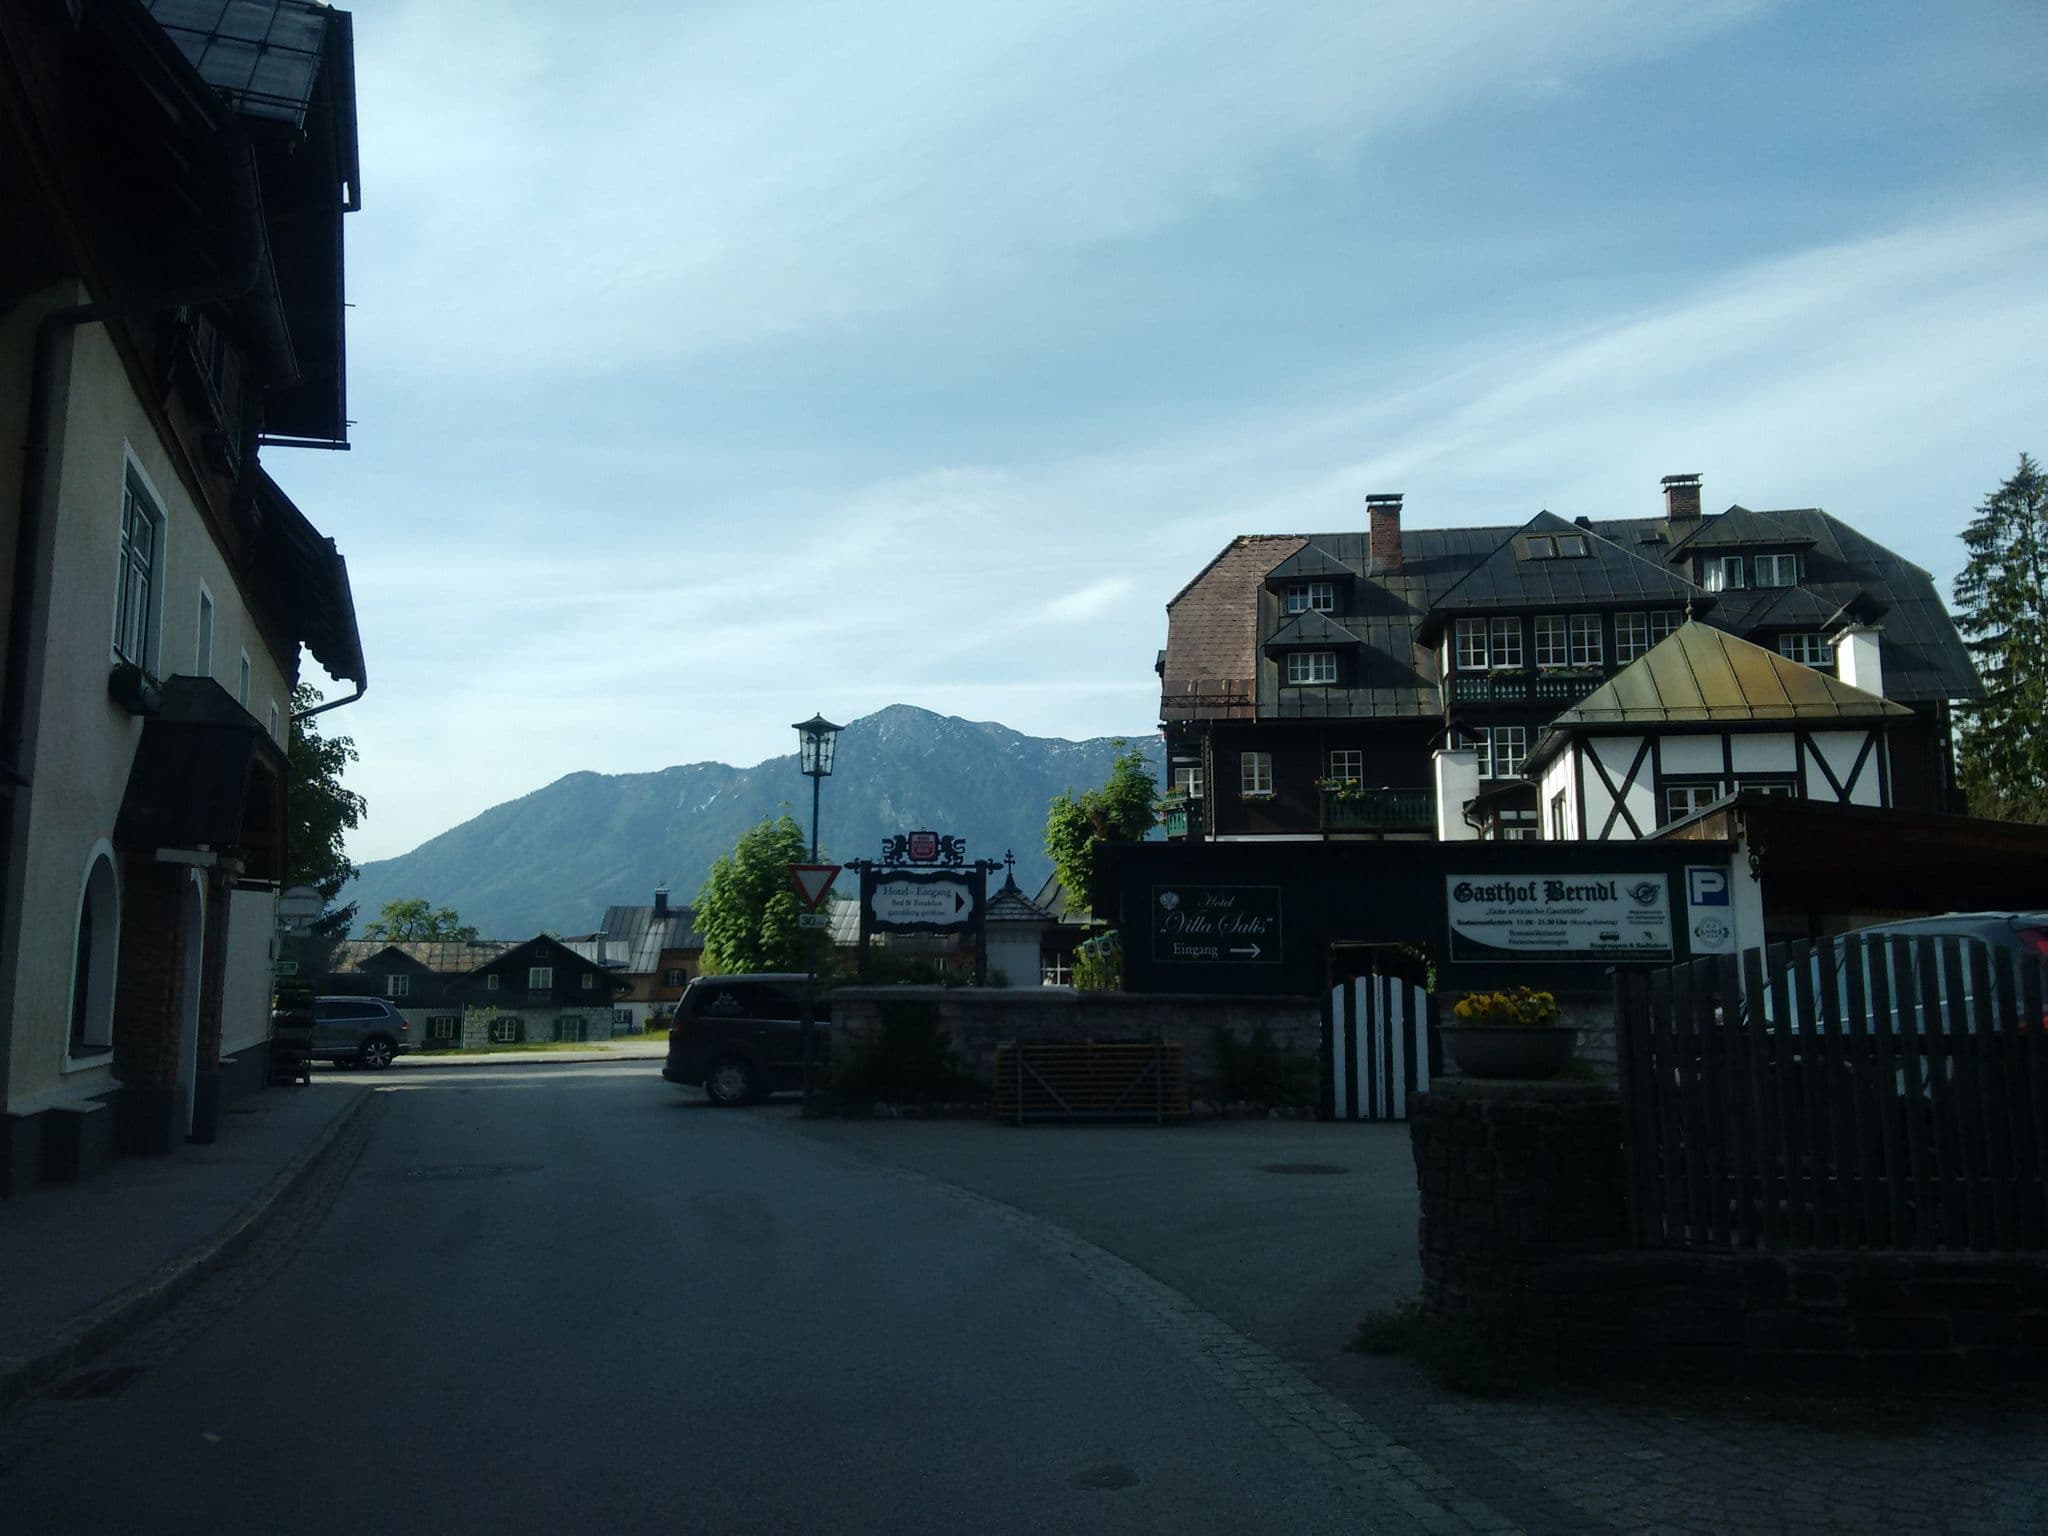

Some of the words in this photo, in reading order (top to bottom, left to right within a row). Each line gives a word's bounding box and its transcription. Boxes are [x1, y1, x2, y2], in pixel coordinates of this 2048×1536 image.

[883, 886, 909, 897] Hotel
[916, 886, 952, 899] Eingang
[1453, 880, 1538, 905] Gasthof
[1544, 880, 1619, 904] Berndl
[1692, 871, 1725, 904] P
[1201, 895, 1236, 908] Hotel
[1172, 942, 1219, 959] Eingang
